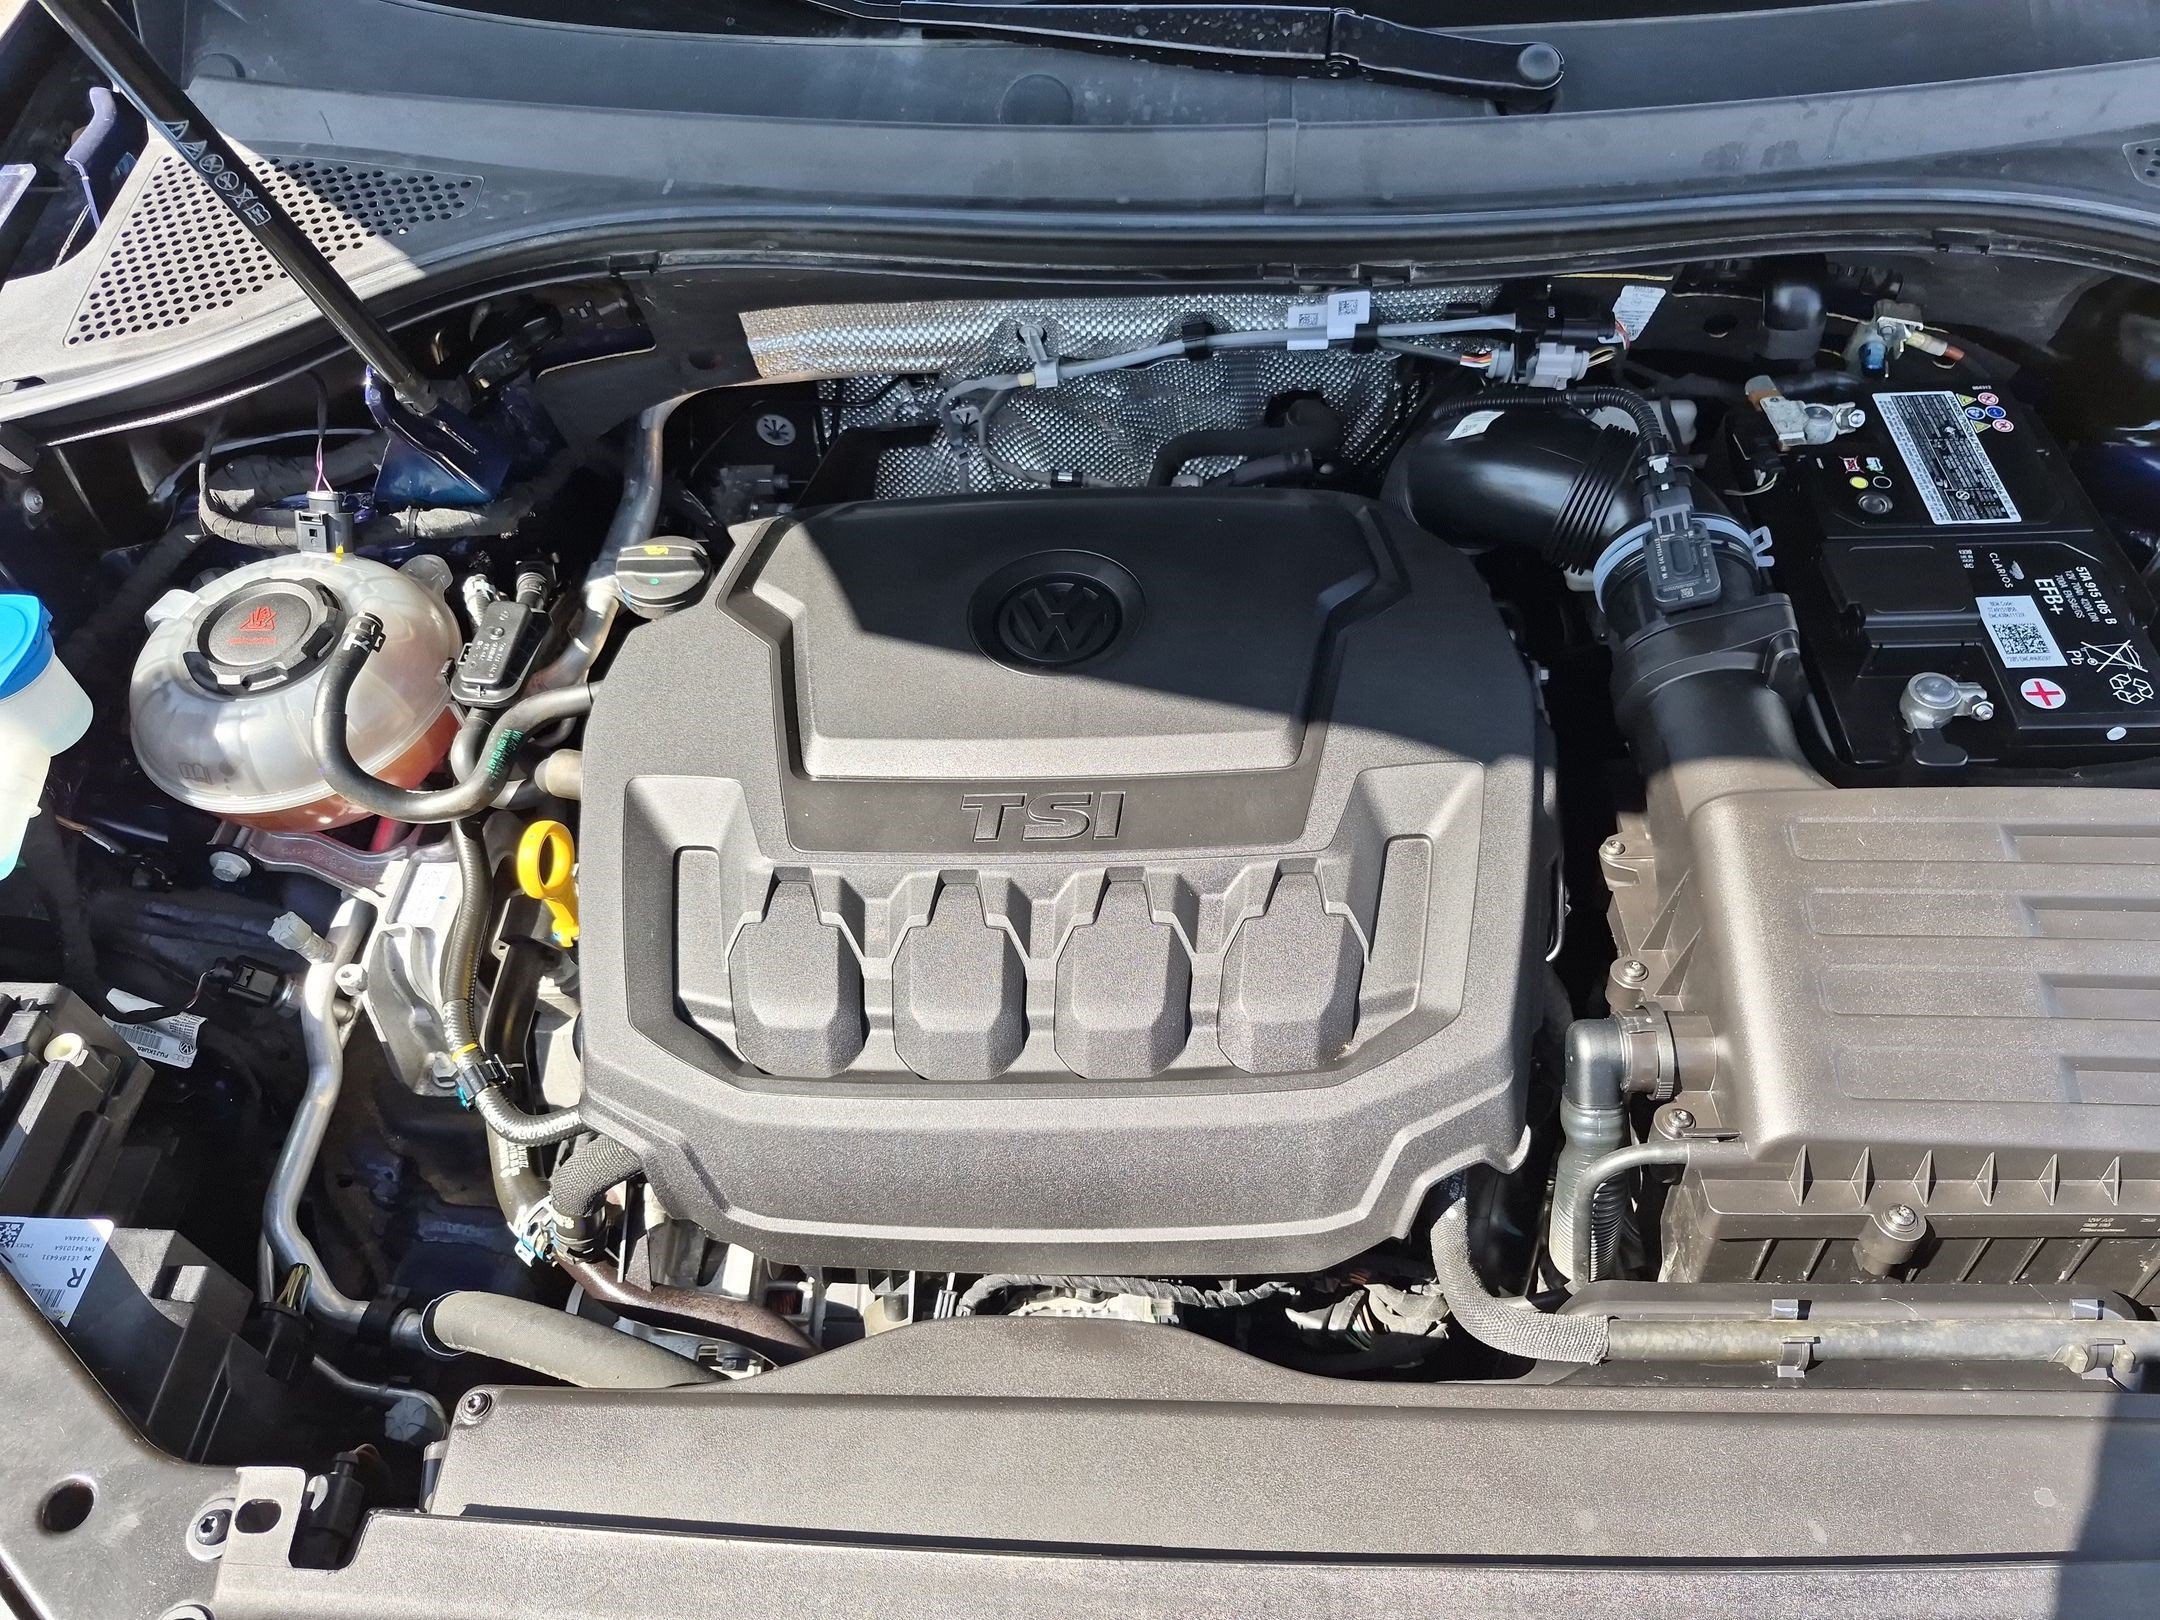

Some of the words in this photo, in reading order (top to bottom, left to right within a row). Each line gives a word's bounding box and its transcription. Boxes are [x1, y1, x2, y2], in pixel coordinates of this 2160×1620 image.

[1989, 552, 2013, 589] CLARIOS
[2034, 578, 2064, 615] EFB+
[2076, 566, 2091, 581] 5TA
[2085, 582, 2102, 597] 915
[2095, 600, 2111, 615] 105
[1001, 577, 1119, 661] VW
[2066, 650, 2082, 665] Pb
[961, 791, 1126, 842] TSI
[137, 1046, 169, 1059] FUJIKURA
[66, 1267, 87, 1288] R
